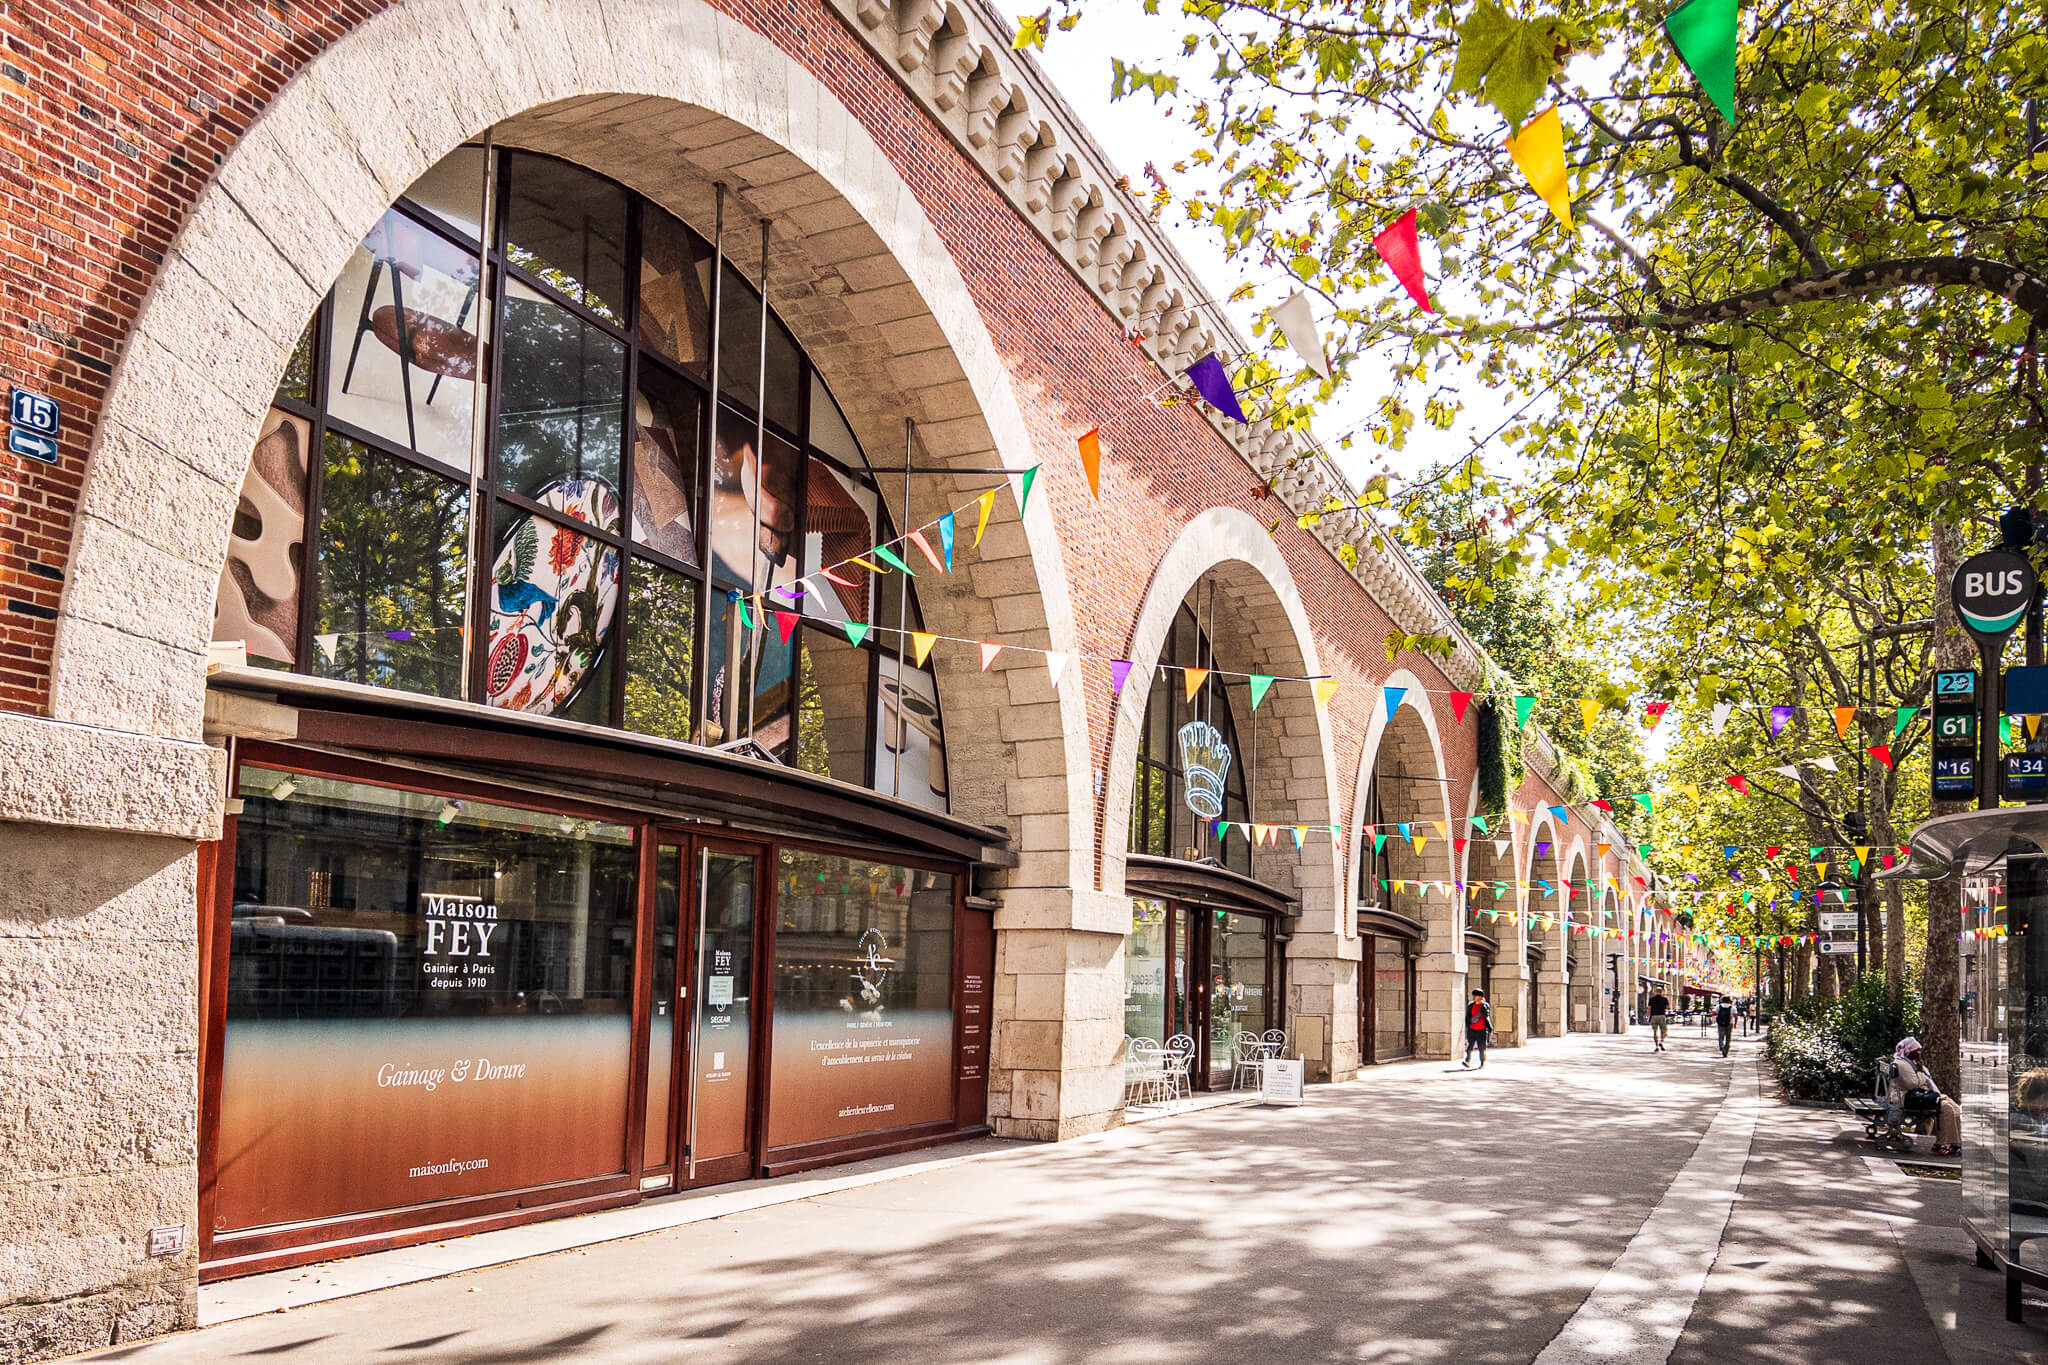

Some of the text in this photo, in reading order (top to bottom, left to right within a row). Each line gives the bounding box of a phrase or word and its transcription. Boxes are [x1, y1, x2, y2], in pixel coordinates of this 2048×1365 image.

[19, 396, 51, 428] 15
[1965, 570, 2023, 598] BUS
[1942, 675, 1969, 691] 29
[1943, 718, 1966, 734] 61
[426, 896, 498, 919] Maison
[424, 920, 497, 956] FEY
[423, 963, 495, 974] Gainier à Paris
[715, 956, 731, 966] FEY
[431, 977, 487, 989] depuis 1910
[377, 1058, 526, 1091] Gainage & Dorure
[408, 1157, 489, 1178] maisonfey.com
